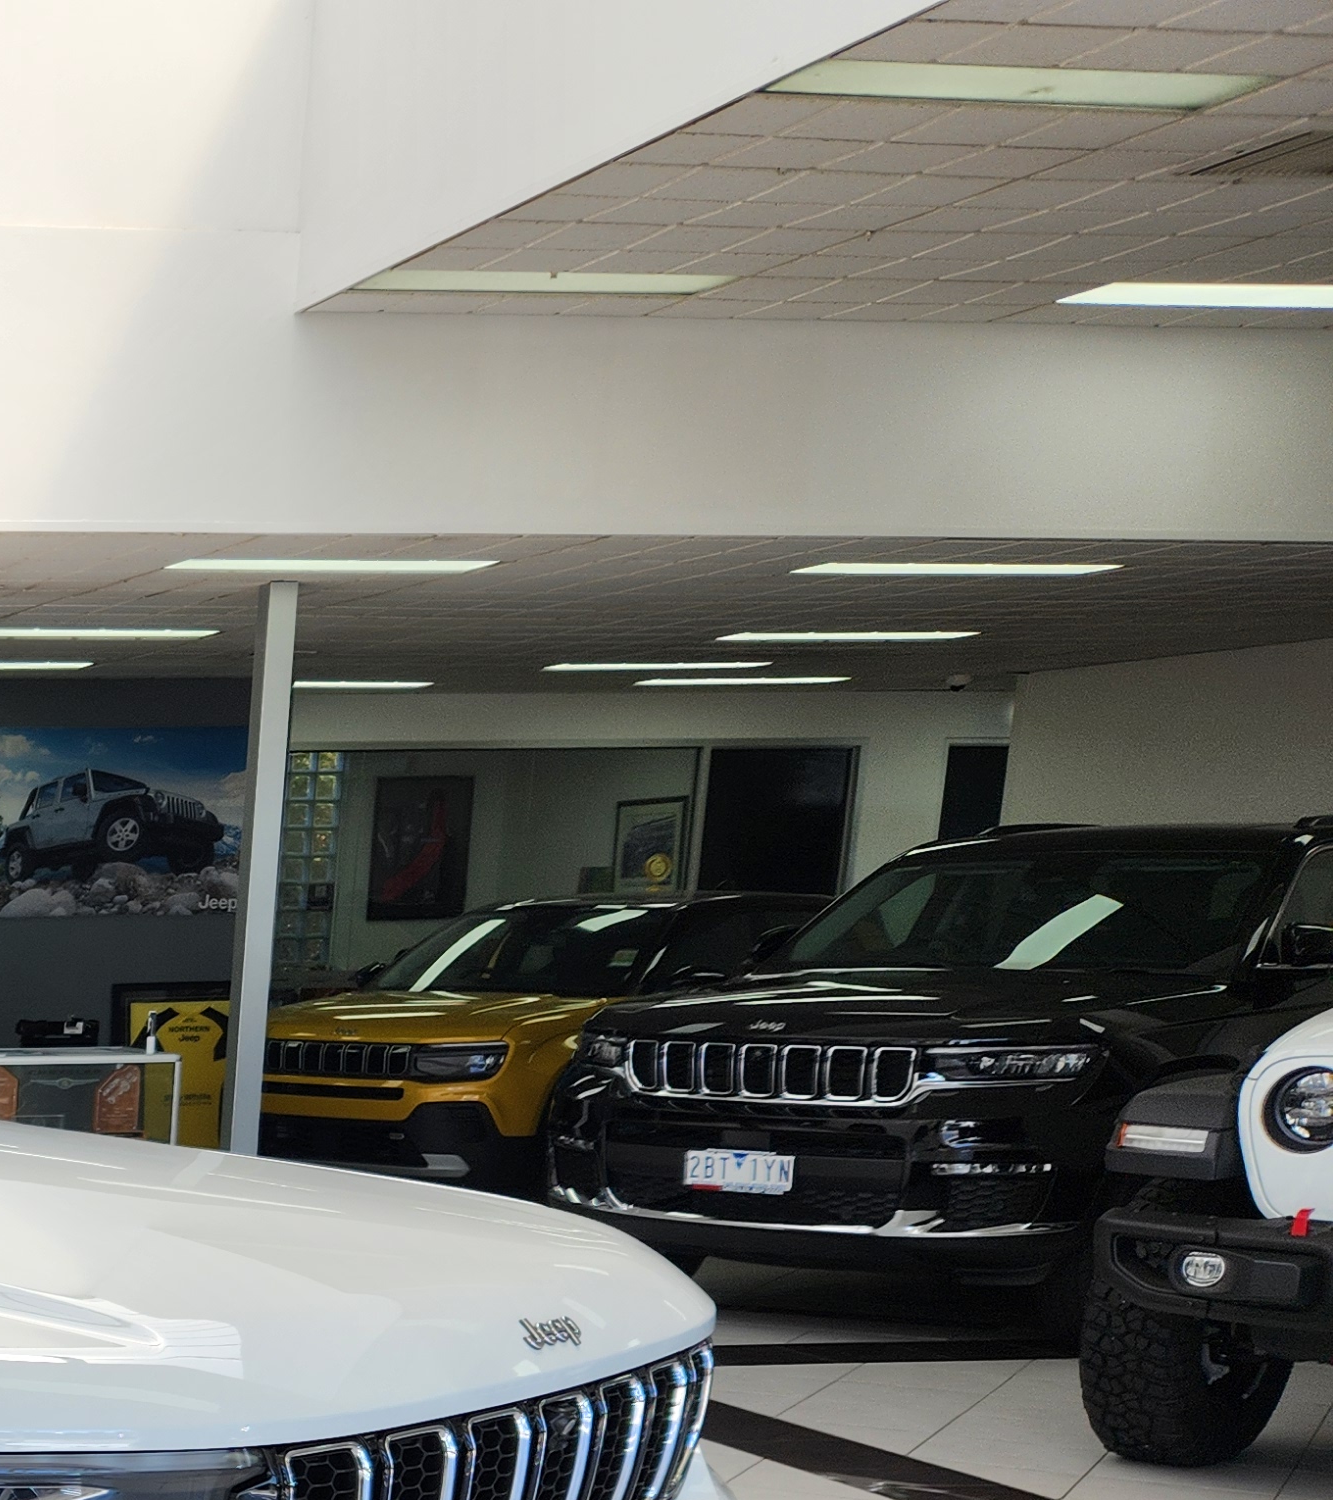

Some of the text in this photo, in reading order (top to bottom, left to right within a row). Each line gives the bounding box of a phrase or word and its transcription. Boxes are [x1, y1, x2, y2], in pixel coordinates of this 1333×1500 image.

[198, 894, 238, 913] Jeep
[168, 1025, 211, 1033] NORTHERN
[749, 1019, 786, 1032] Jeep
[178, 1034, 201, 1043] Jeep
[690, 1155, 791, 1182] 2BT 1YN
[519, 1316, 581, 1350] Jeep
